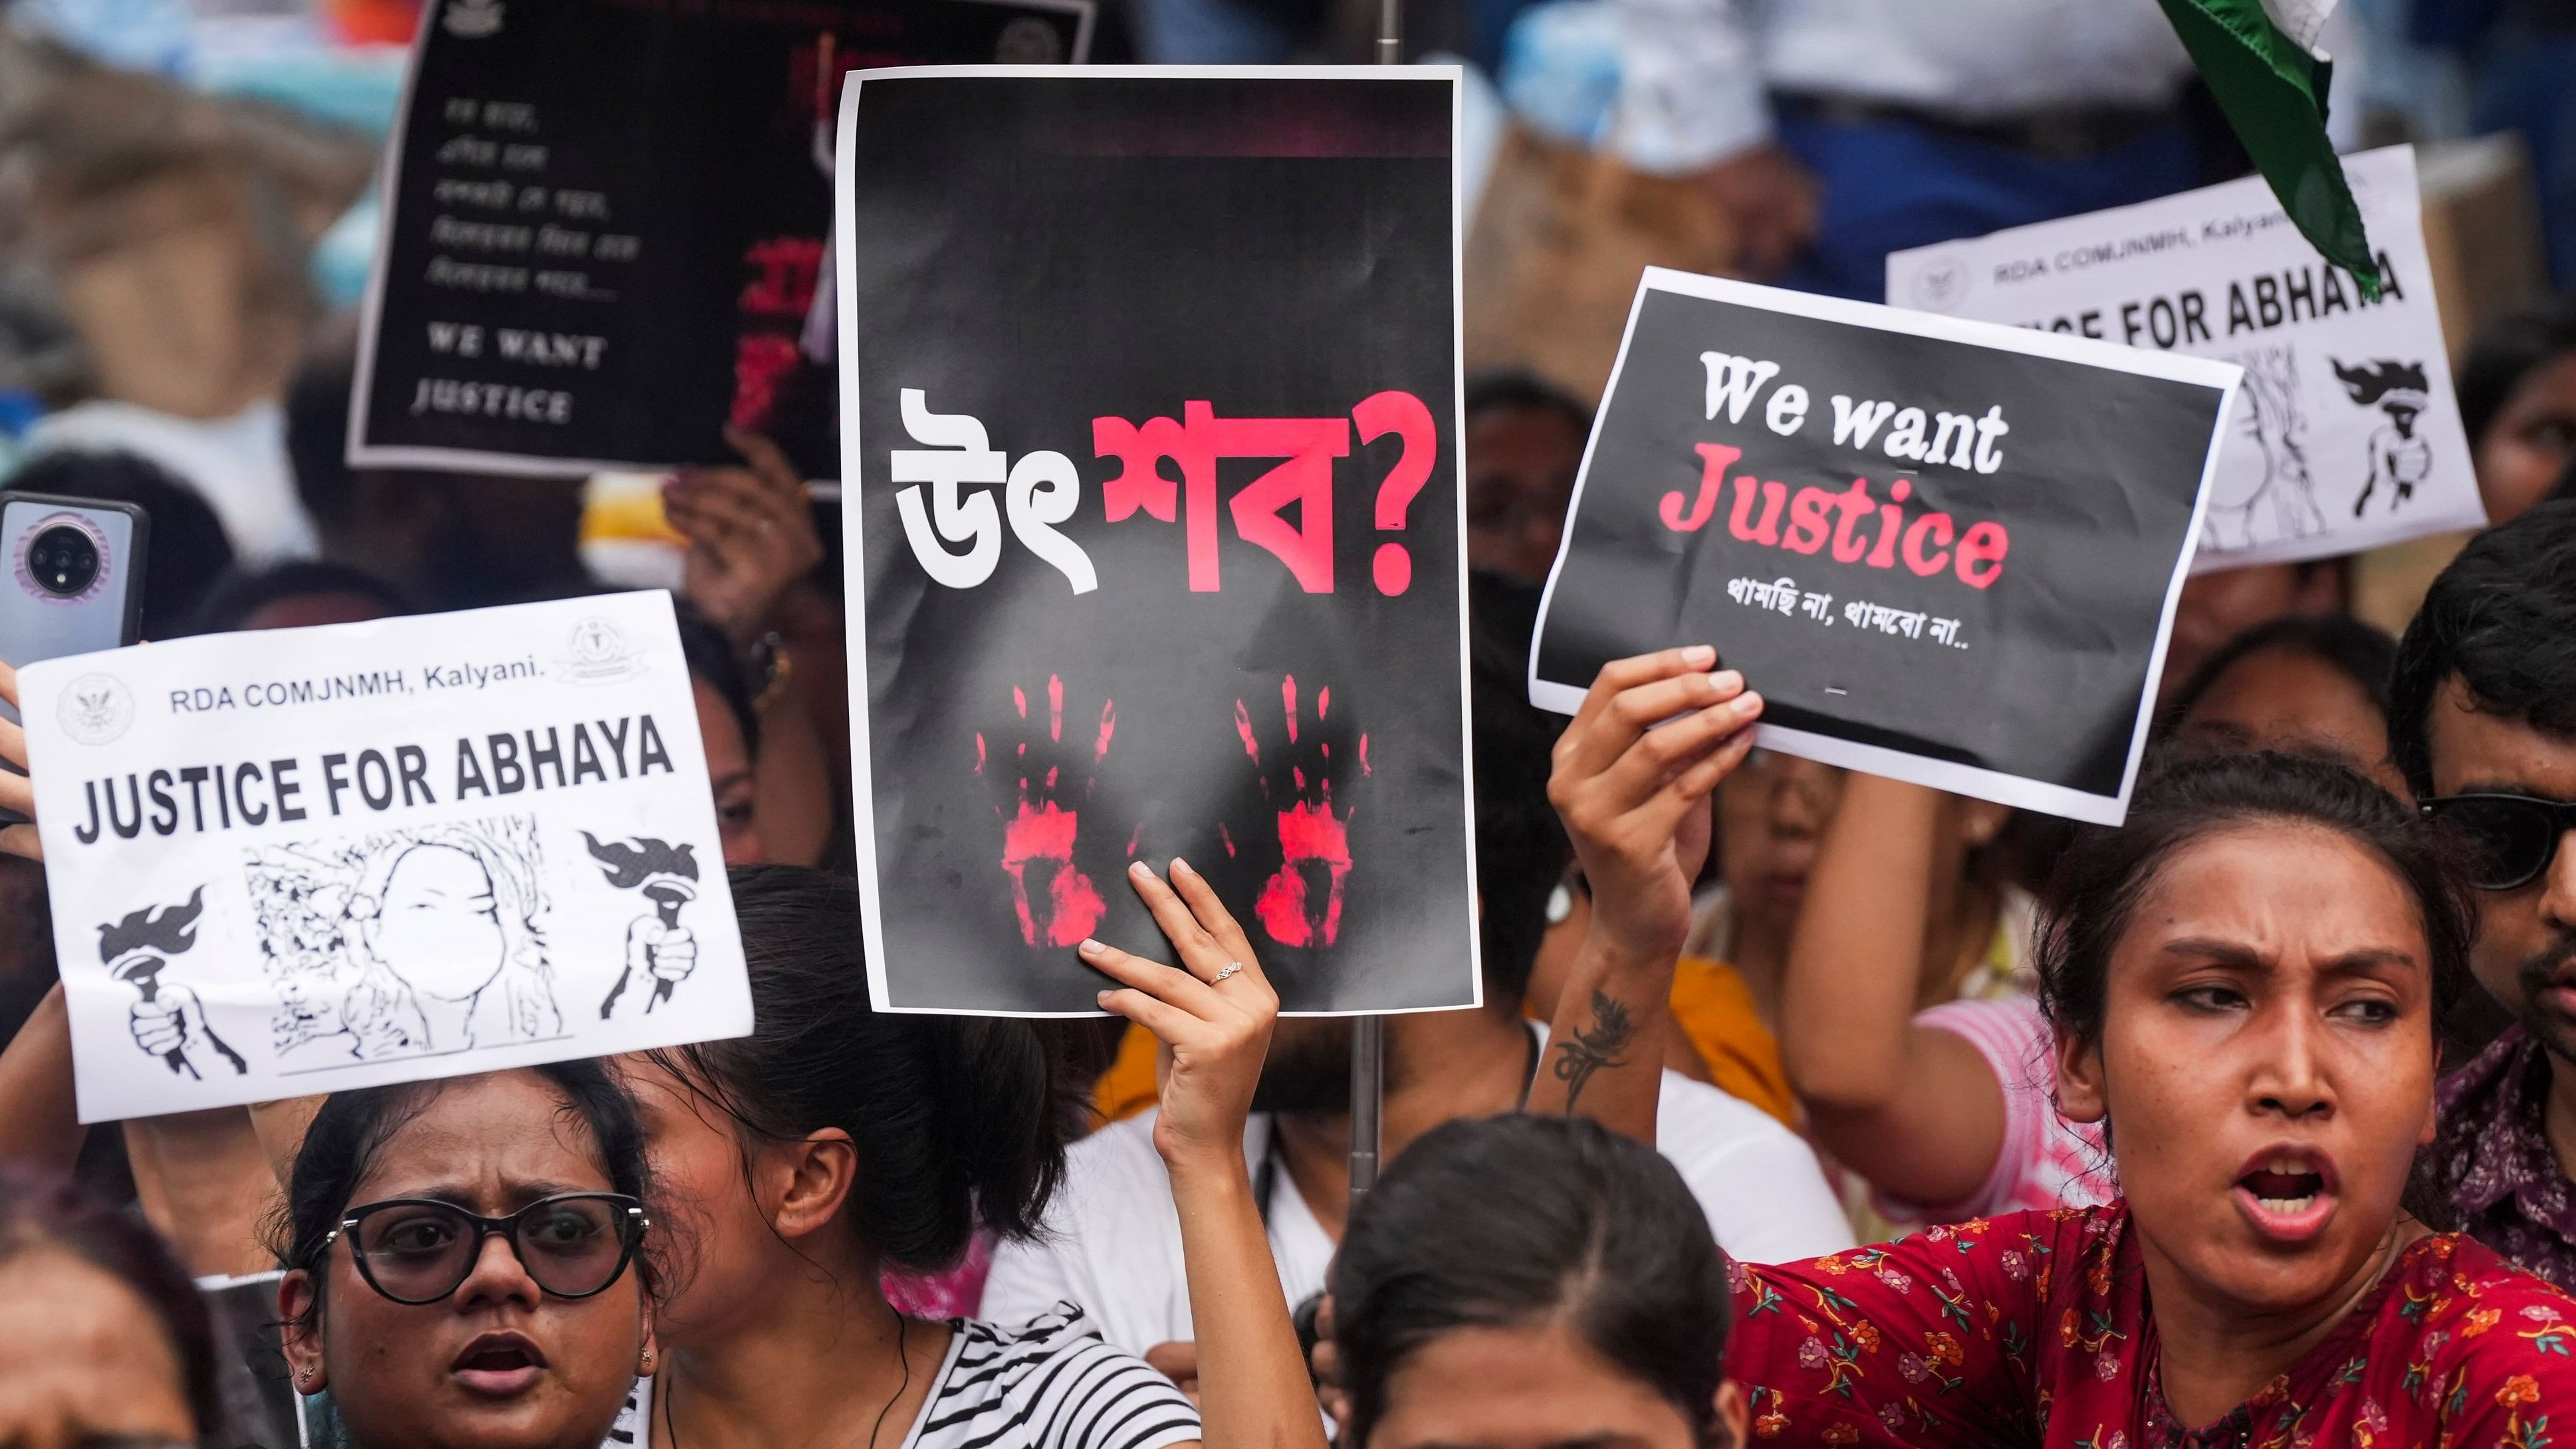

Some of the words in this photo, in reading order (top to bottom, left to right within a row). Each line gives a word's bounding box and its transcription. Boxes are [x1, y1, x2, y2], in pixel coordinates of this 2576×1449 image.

[2201, 210, 2288, 239] Kalyan
[2120, 290, 2212, 350] FOR
[2228, 248, 2404, 336] ABHAA
[427, 321, 485, 359] WE
[497, 327, 608, 370] WANT
[409, 378, 574, 424] JUSTICE
[1698, 350, 1810, 437] We
[1829, 393, 2010, 475] want
[1658, 441, 2010, 590] Justice
[1726, 576, 1800, 617] থামছি
[1801, 592, 1835, 627] না,
[1843, 600, 1929, 640] থামবো
[1929, 617, 1970, 650] না..
[170, 686, 235, 713] RDA
[244, 670, 415, 708] COMJNMH,
[426, 655, 546, 690] Kalyani.
[74, 758, 307, 845] JUSTICE
[322, 744, 436, 816] FOR
[457, 714, 674, 800] ABHAYA
